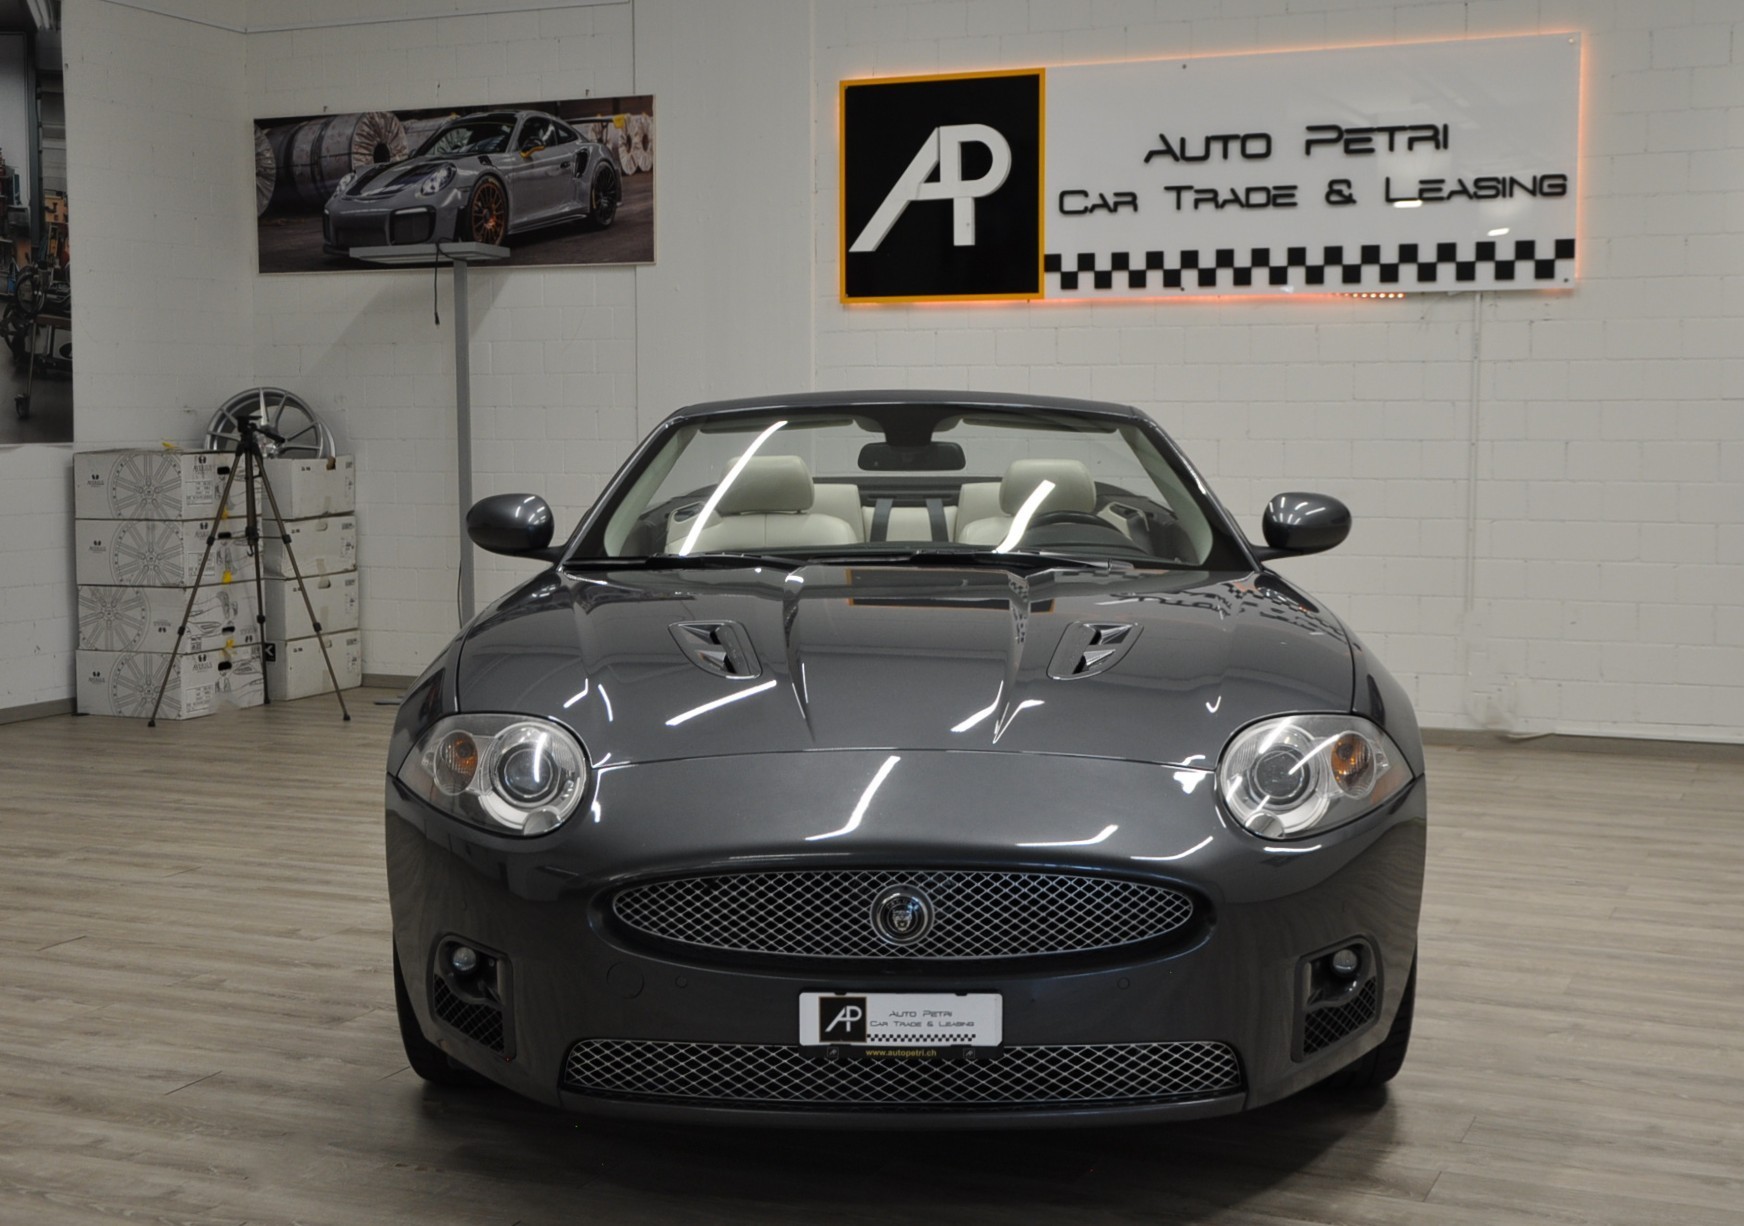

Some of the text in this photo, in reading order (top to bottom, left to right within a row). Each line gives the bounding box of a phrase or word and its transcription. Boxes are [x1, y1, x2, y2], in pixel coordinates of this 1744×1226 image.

[1144, 123, 1449, 163] AUTO PETRI
[849, 123, 1011, 252] AP
[1058, 173, 1568, 216] CAR TRADE & LEASING
[889, 1010, 952, 1018] AUTO PETRI
[865, 1048, 937, 1057] www.autopetri.ch
